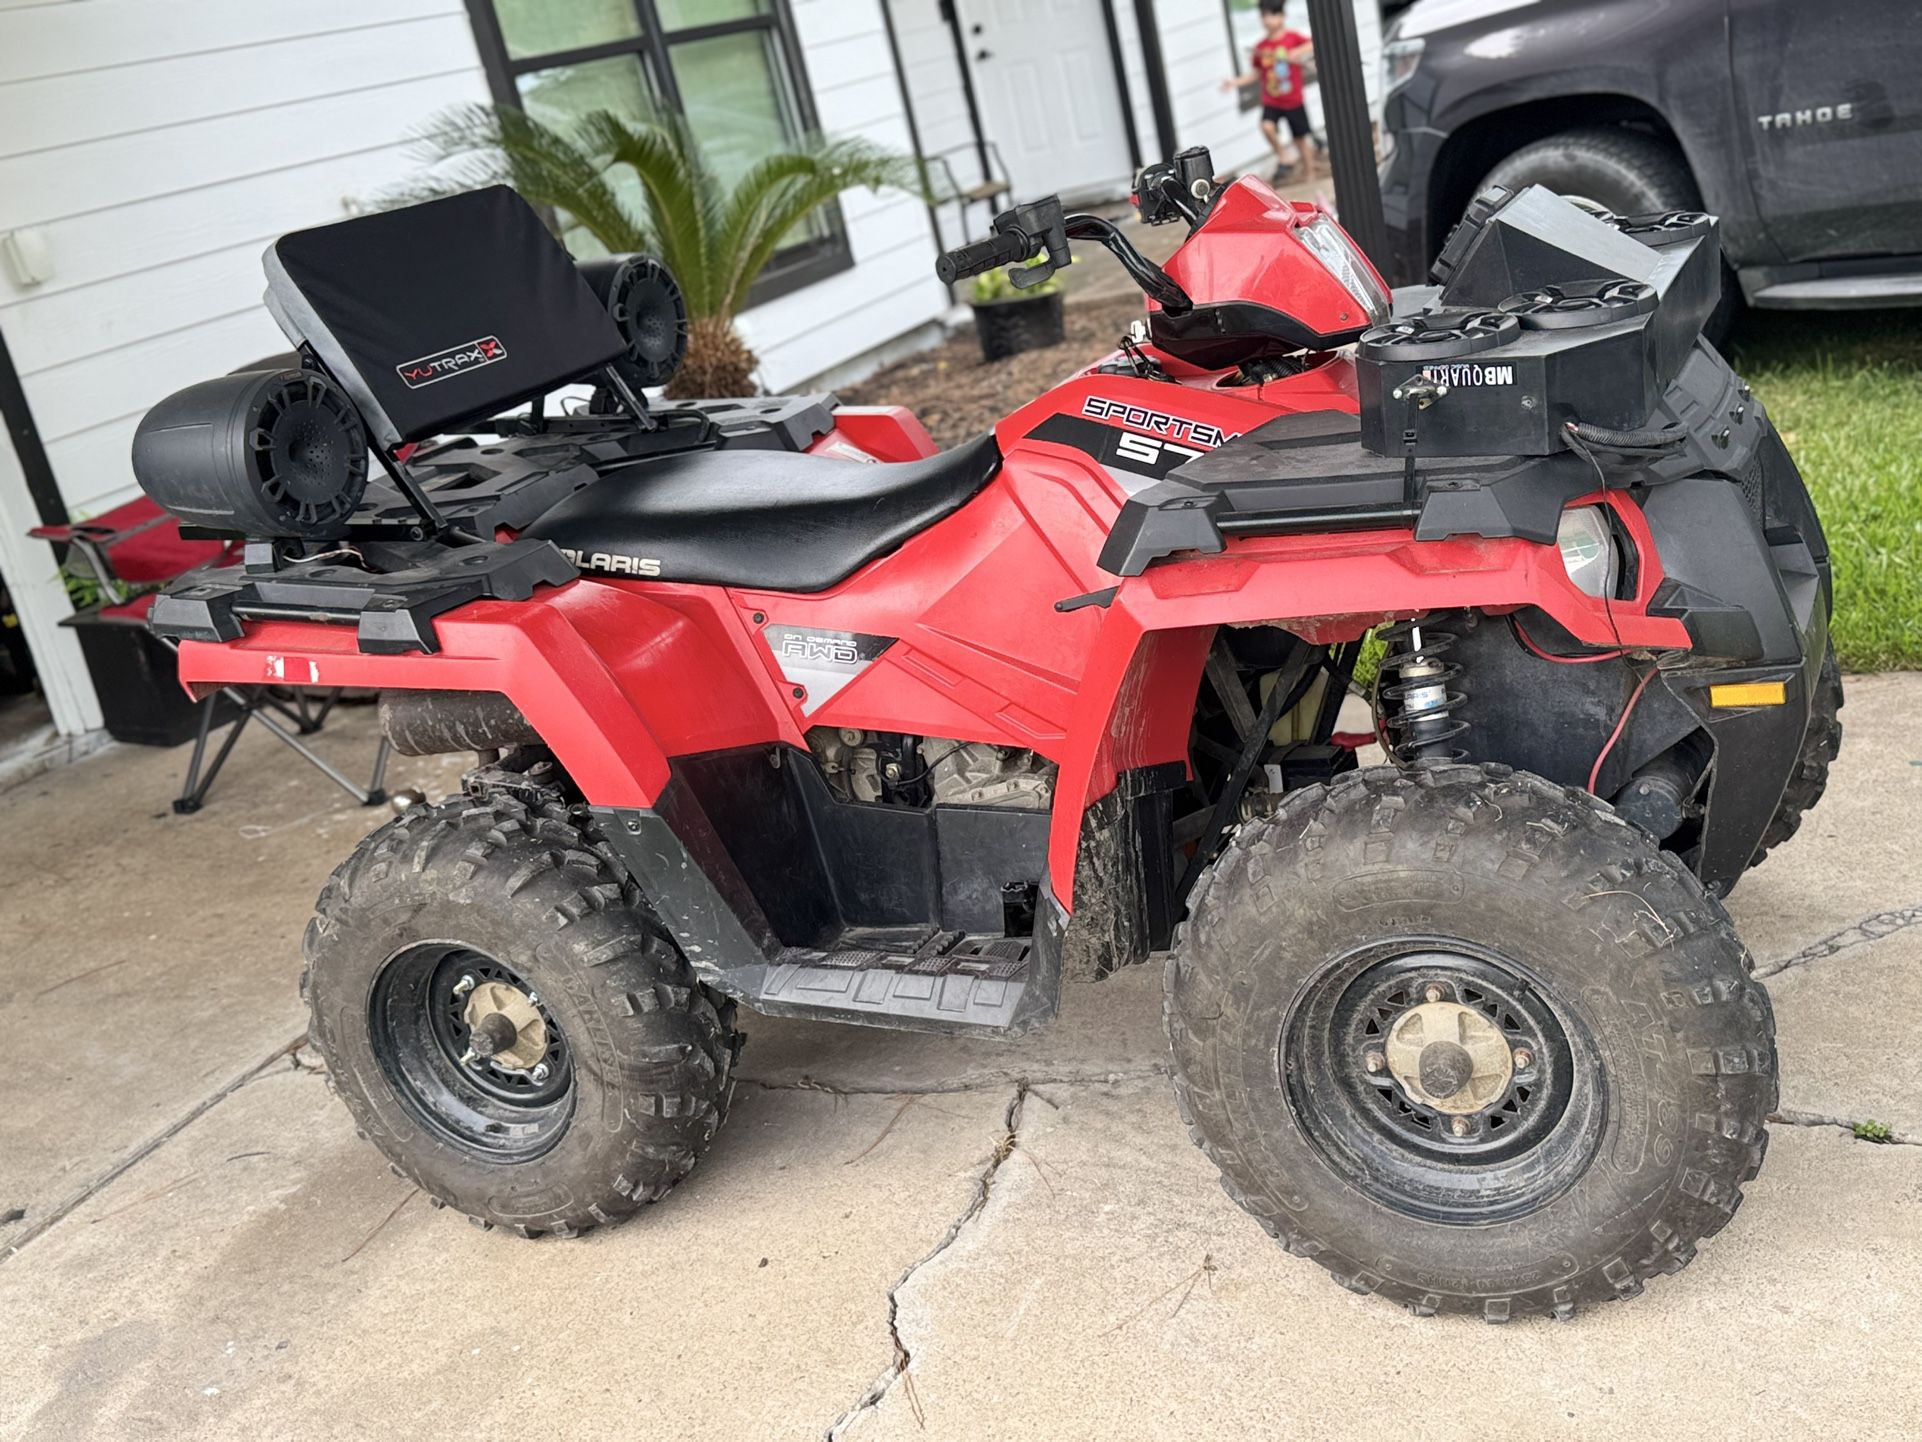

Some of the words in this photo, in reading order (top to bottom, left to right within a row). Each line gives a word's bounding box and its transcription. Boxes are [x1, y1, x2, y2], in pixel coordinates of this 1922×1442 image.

[1757, 103, 1853, 130] TAHOE
[781, 639, 858, 665] AWD
[783, 633, 802, 641] ON
[806, 634, 857, 647] DEMAND
